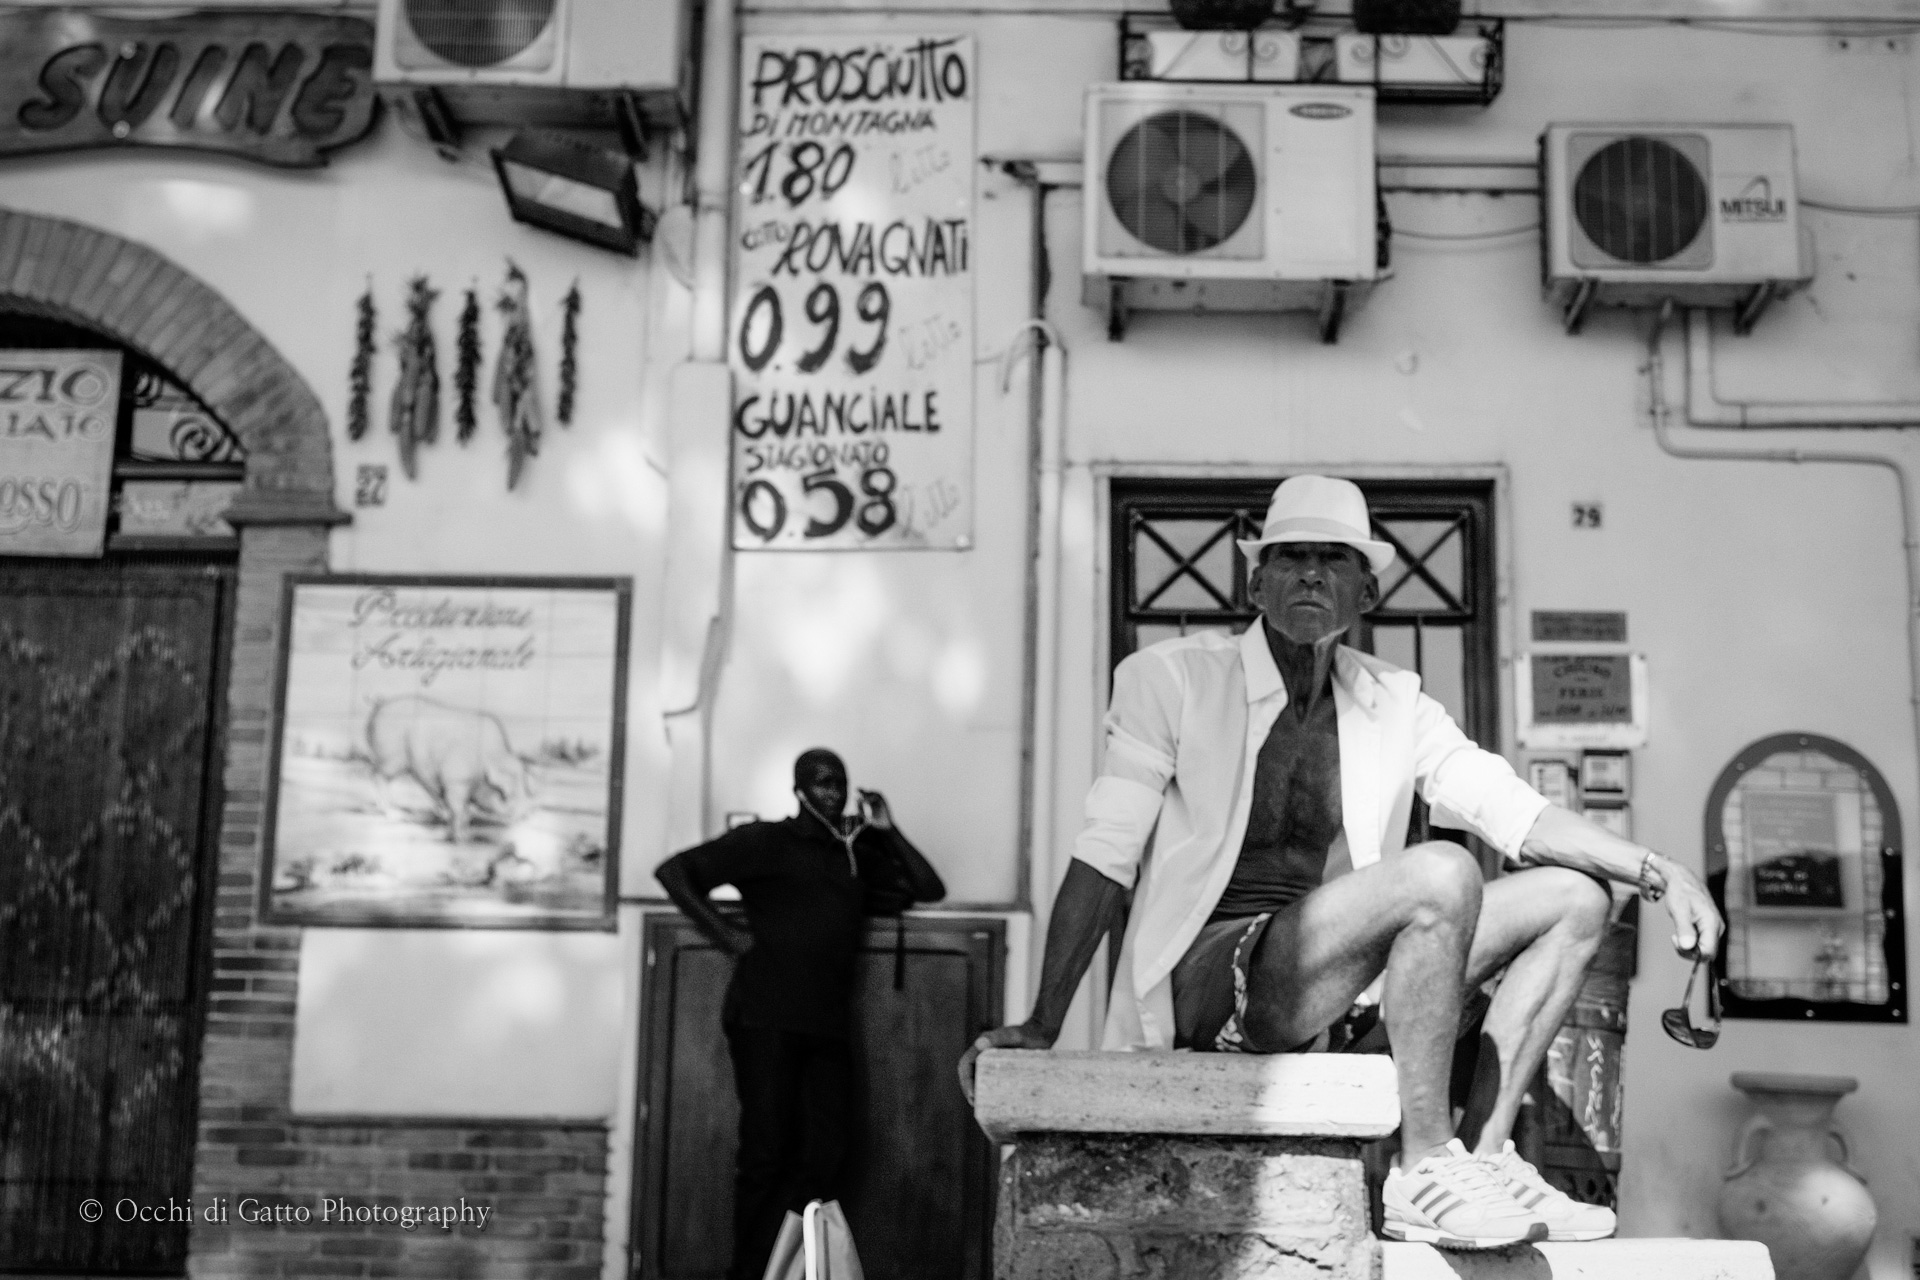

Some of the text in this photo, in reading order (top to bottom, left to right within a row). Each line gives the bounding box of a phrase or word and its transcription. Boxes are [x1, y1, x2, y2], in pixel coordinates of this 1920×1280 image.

[18, 42, 373, 137] SUINE
[752, 36, 967, 105] PROSCIUTTO
[742, 109, 936, 137] DI MONTAGNA
[770, 218, 969, 277] ROVAGNATI
[735, 386, 942, 439] GUANCIALE
